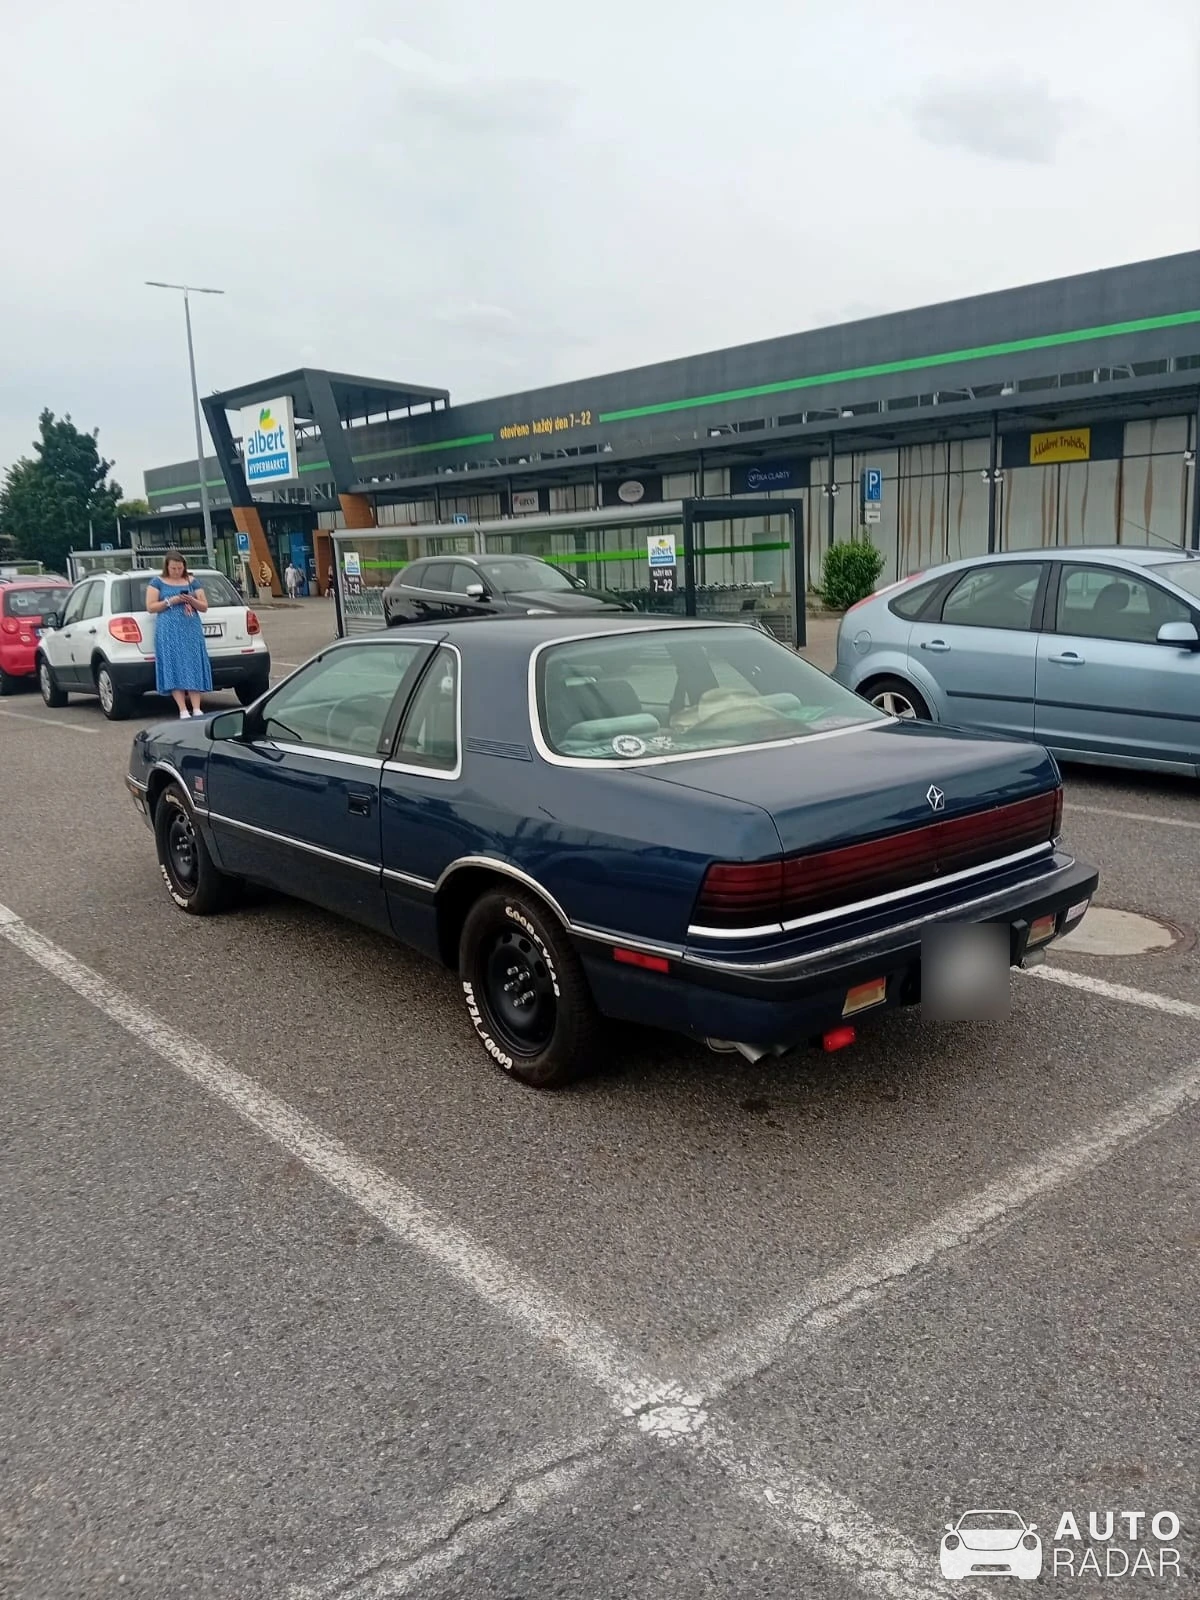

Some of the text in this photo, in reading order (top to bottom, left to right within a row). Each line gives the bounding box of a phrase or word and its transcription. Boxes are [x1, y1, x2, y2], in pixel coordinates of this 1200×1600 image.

[533, 417, 552, 434] každý
[555, 416, 568, 430] den
[248, 425, 286, 455] albert
[249, 457, 287, 475] HYPERMARKET
[869, 471, 879, 493] P
[239, 535, 247, 545] P
[651, 544, 672, 556] albert
